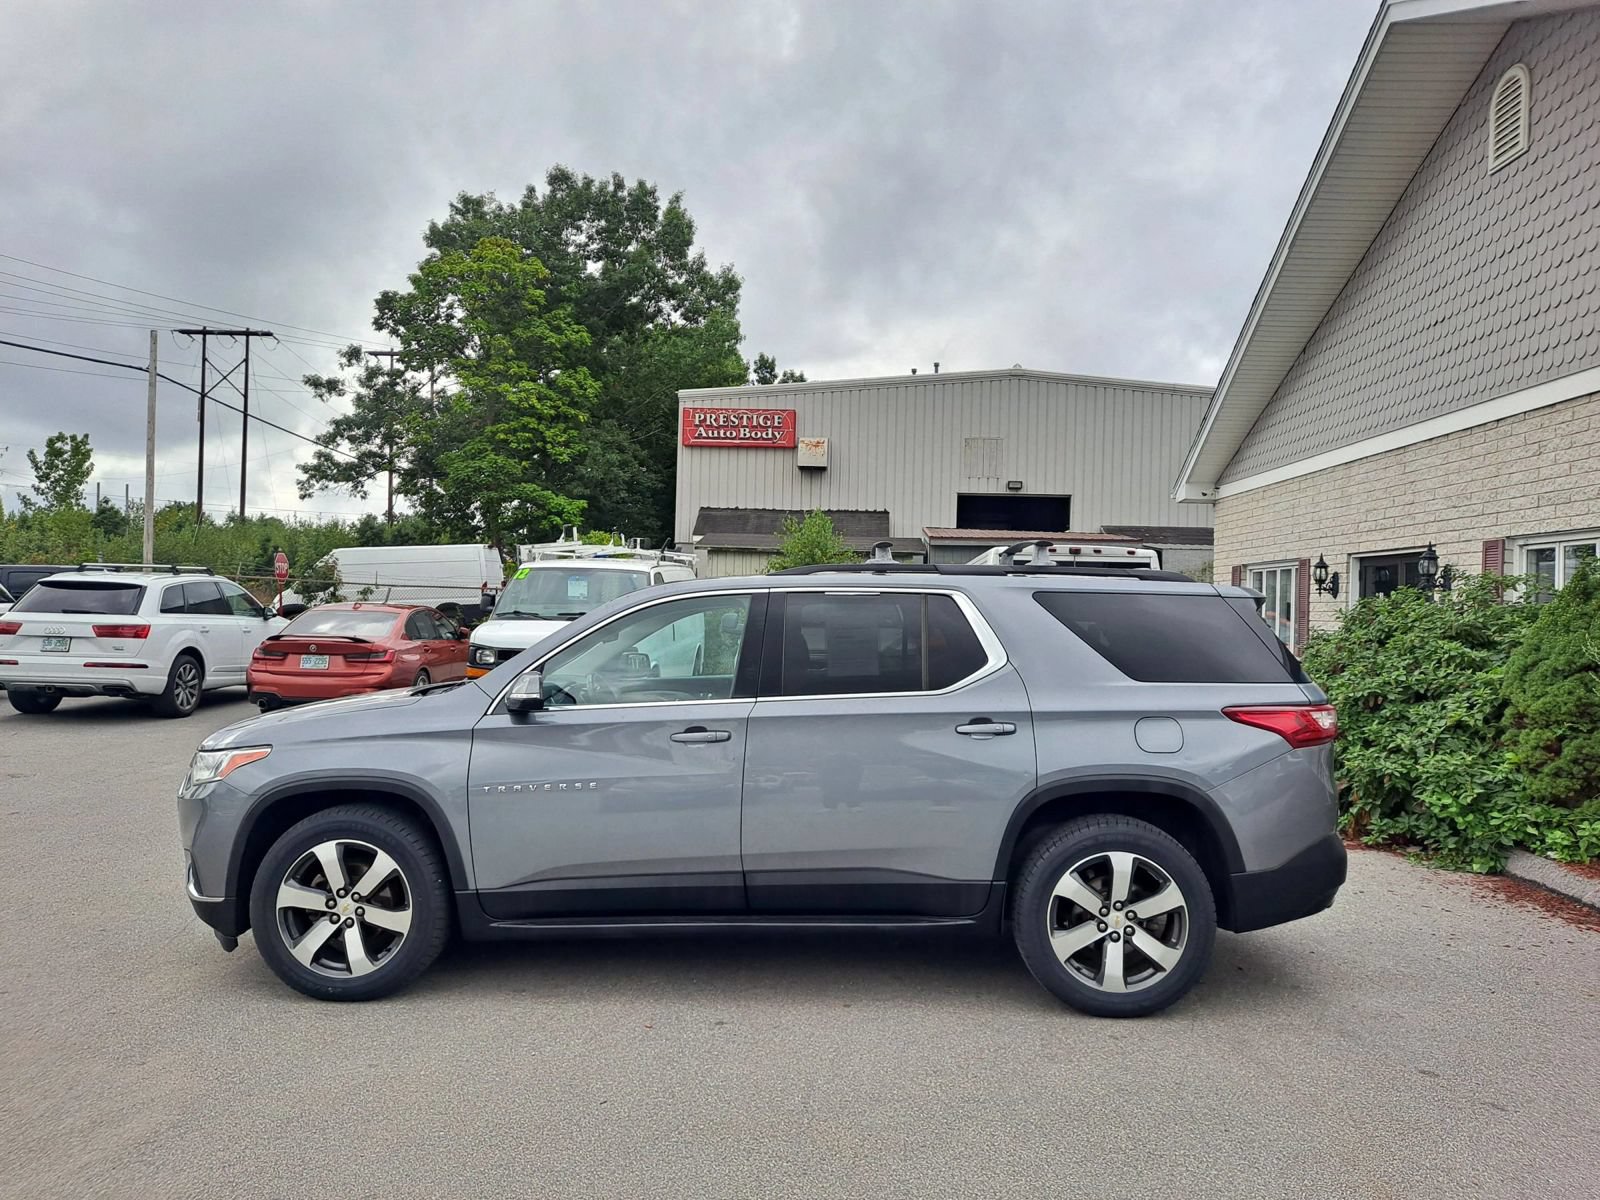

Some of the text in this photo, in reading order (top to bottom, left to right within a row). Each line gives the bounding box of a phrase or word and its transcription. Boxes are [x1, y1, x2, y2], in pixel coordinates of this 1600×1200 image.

[694, 413, 783, 427] PRESTIGE
[694, 427, 783, 441] Auto Body
[276, 562, 288, 574] STOP
[483, 782, 597, 793] TRAVERSE
